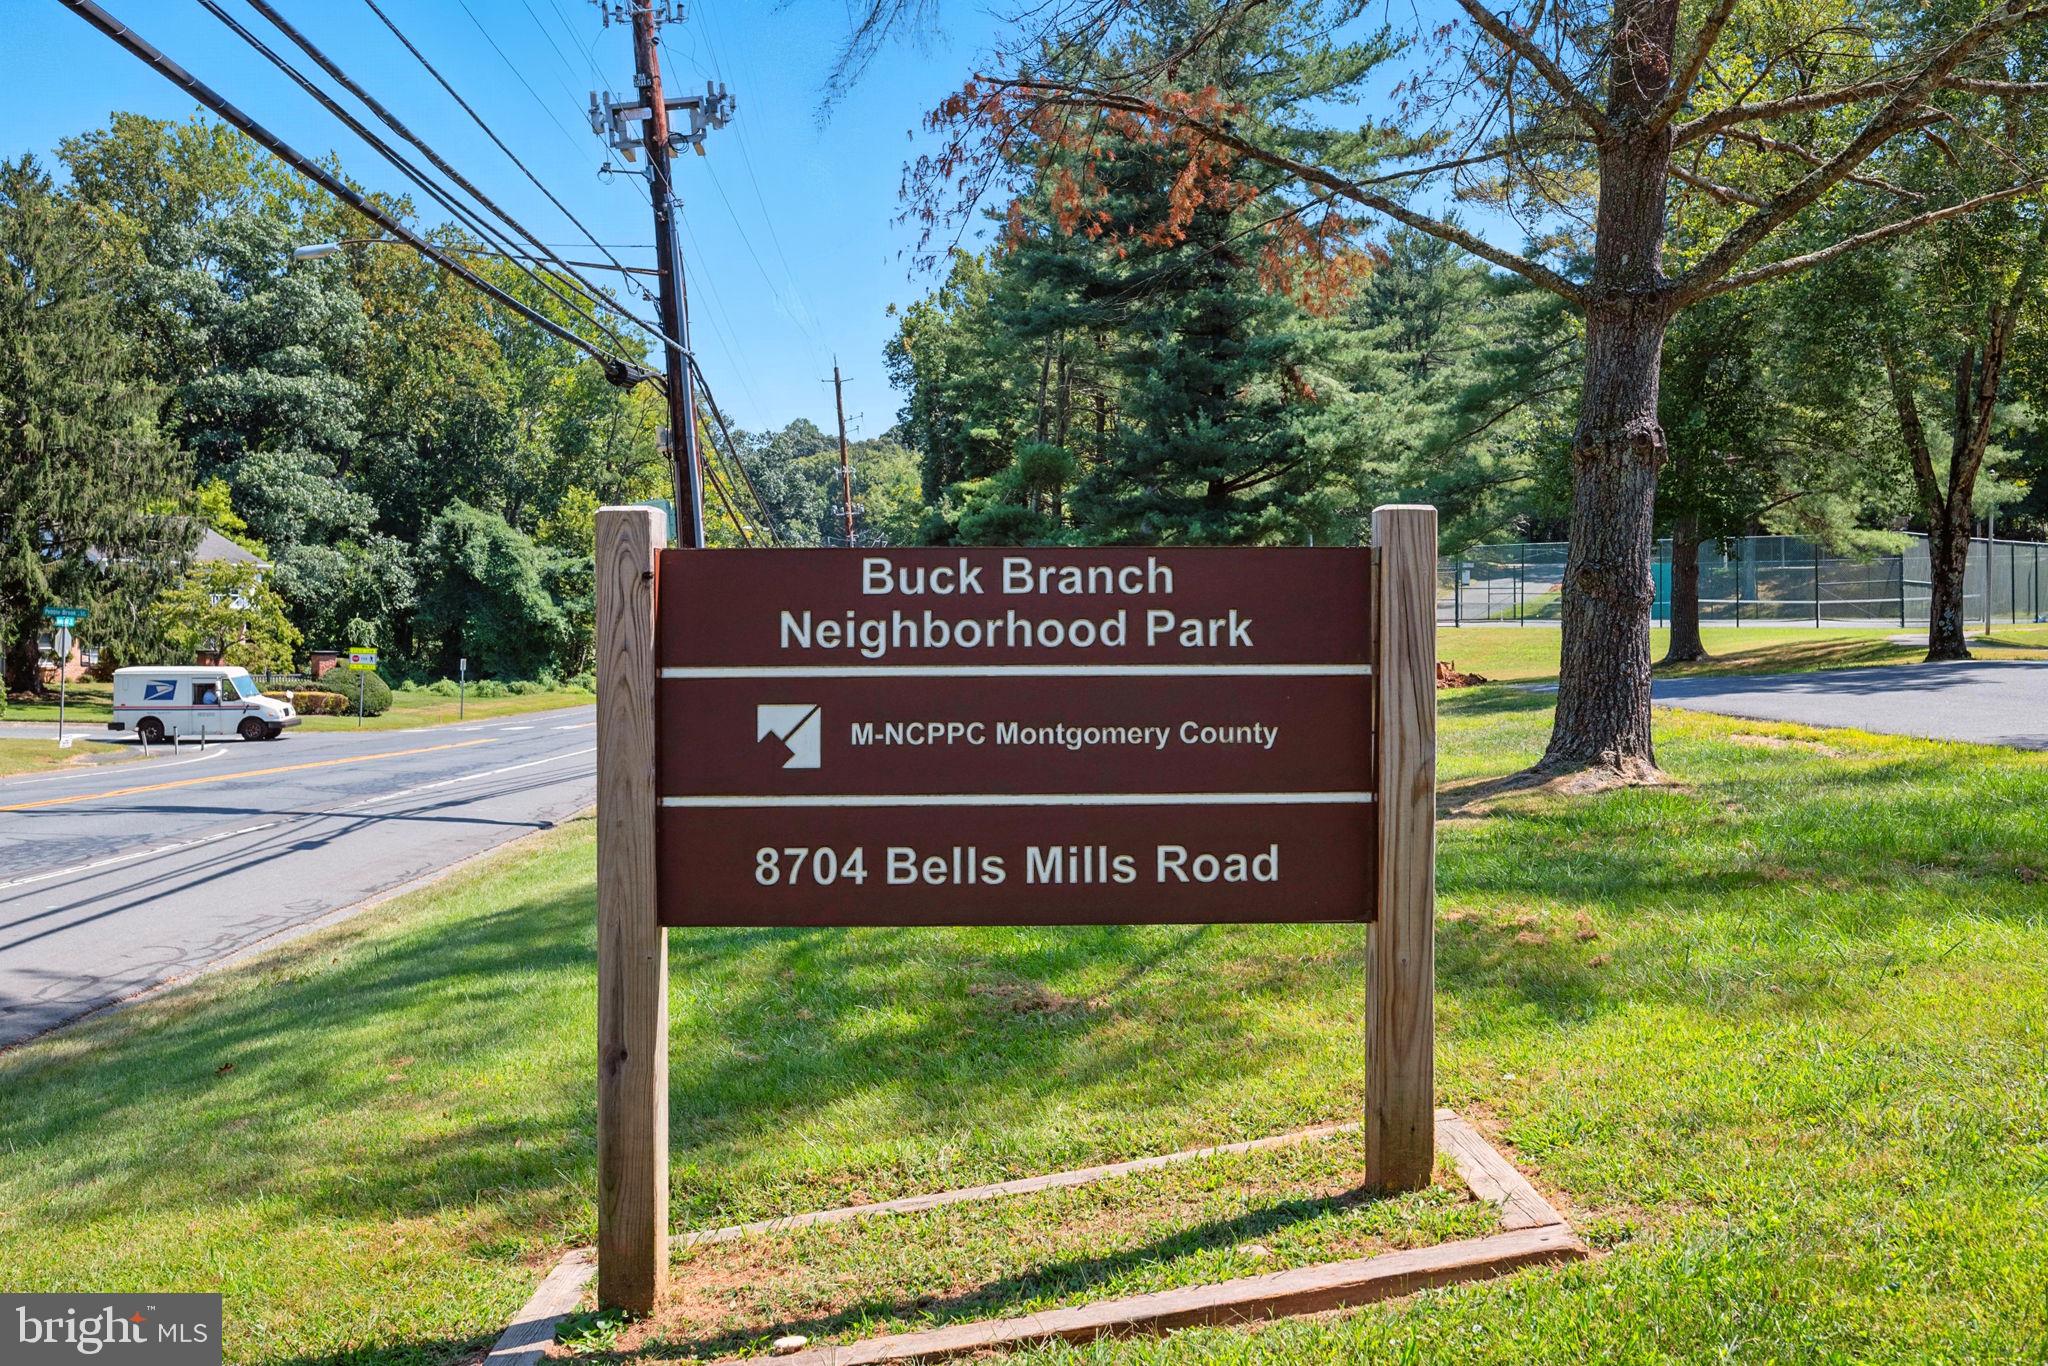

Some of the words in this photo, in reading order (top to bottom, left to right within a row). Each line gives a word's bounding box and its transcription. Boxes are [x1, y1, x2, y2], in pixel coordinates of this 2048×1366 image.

[862, 557, 985, 595] Buck
[1002, 556, 1173, 595] Branch
[780, 609, 1126, 659] Neighborhood
[1147, 609, 1254, 647] Park
[851, 722, 986, 745] M-NCPPC
[996, 722, 1171, 750] Montgomery
[1179, 720, 1278, 750] County
[755, 846, 868, 885] 8704
[887, 846, 1006, 885] Bells
[1026, 845, 1137, 884] Mills
[1157, 844, 1278, 883] Road
